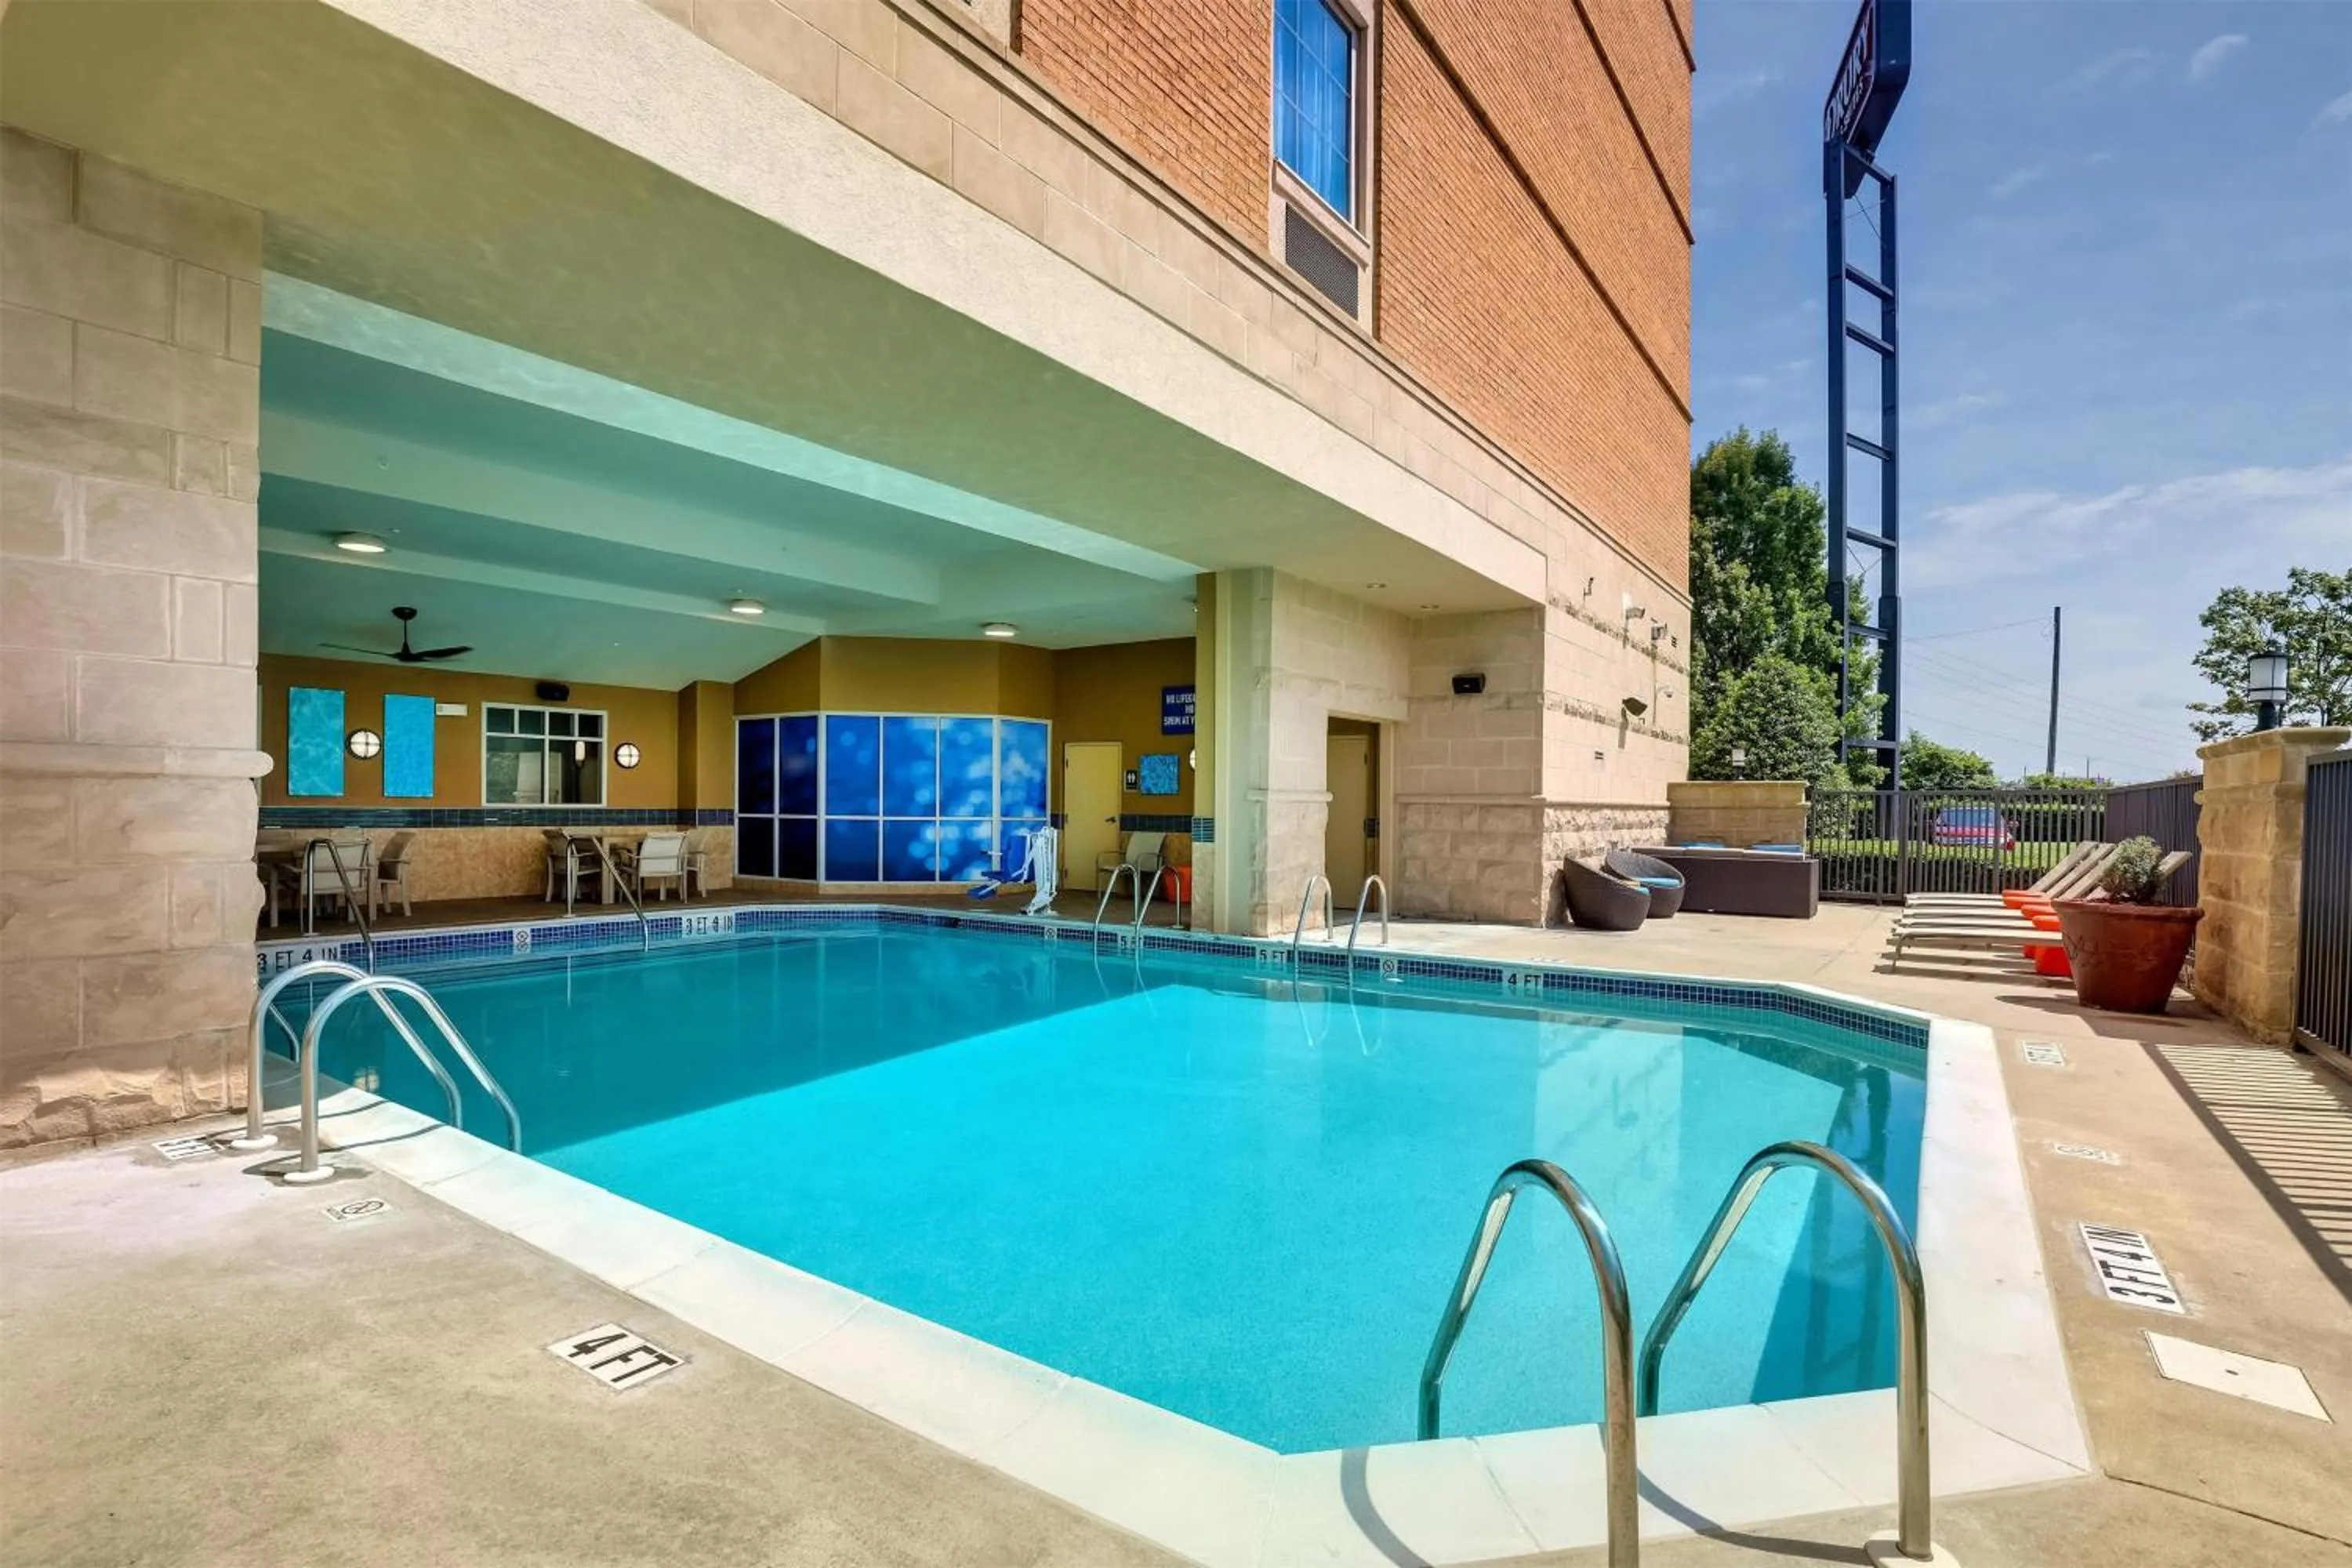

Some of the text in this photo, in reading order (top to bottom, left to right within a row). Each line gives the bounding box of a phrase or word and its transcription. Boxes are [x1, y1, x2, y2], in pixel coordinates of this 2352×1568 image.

[321, 947, 338, 960] IN
[1508, 973, 1541, 987] 4 FT
[2083, 1225, 2176, 1304] 3 FT 4 IN
[567, 1332, 678, 1383] 4 FT
